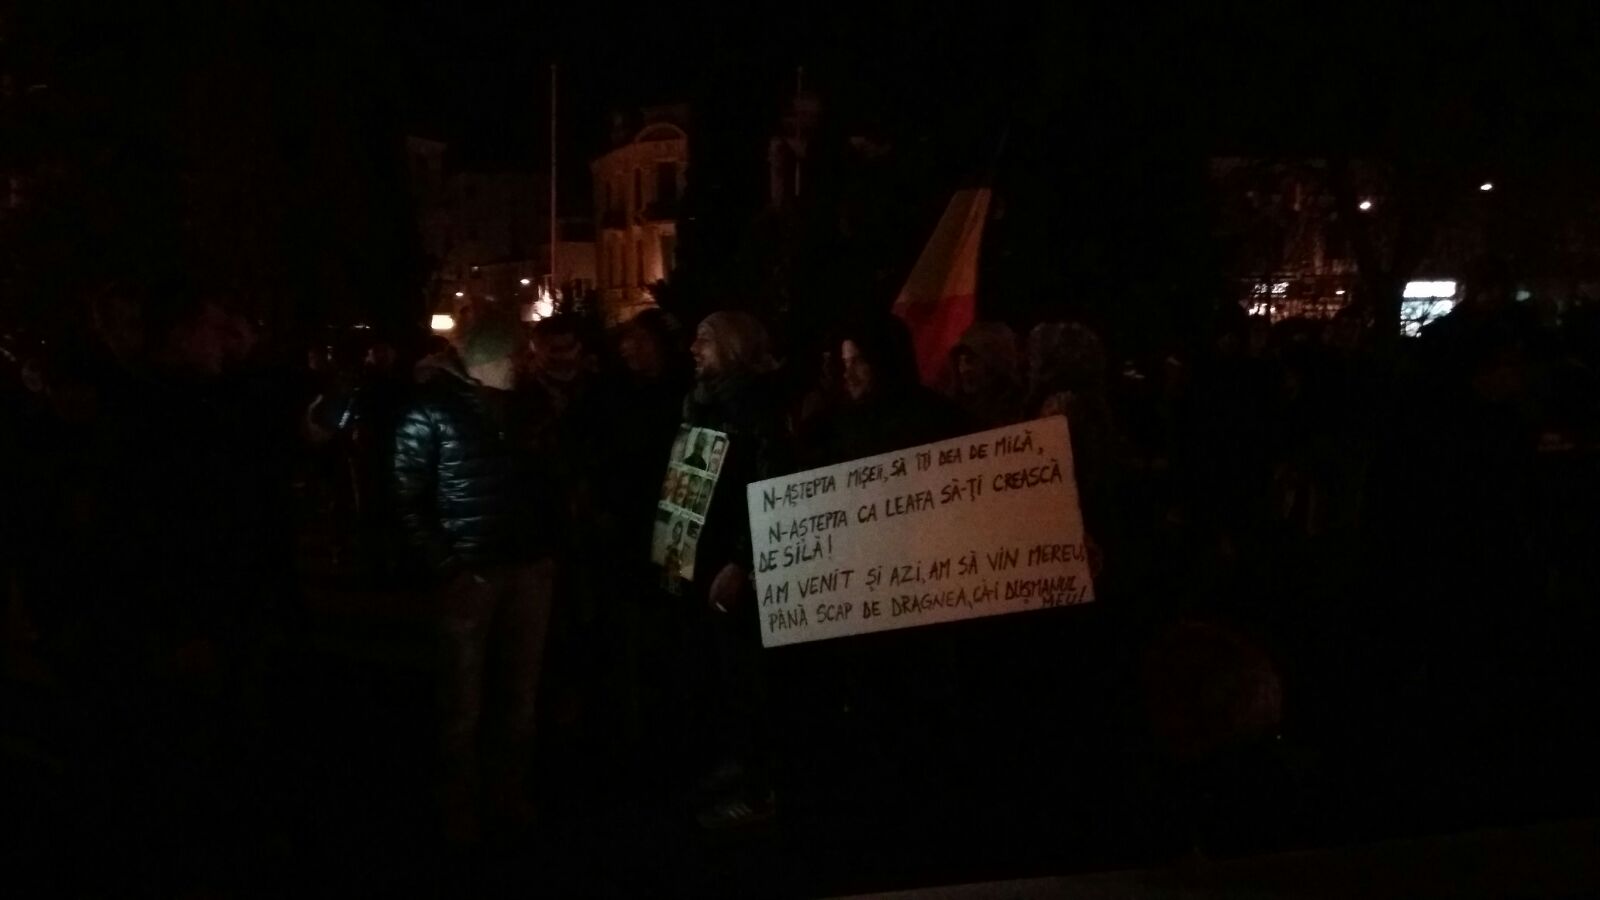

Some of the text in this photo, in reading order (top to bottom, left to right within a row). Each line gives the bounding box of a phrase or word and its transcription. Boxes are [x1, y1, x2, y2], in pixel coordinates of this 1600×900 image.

[939, 447, 962, 466] DEA
[969, 443, 988, 460] DE
[857, 503, 877, 523] CA
[886, 490, 935, 517] LEAFA
[993, 458, 1063, 492] CREASCĂ
[759, 552, 777, 573] DE
[763, 580, 789, 606] AM
[799, 569, 854, 598] VENIT
[929, 558, 950, 581] AM
[987, 547, 1019, 571] VIN
[817, 602, 853, 623] SCAP
[863, 601, 881, 619] DE
